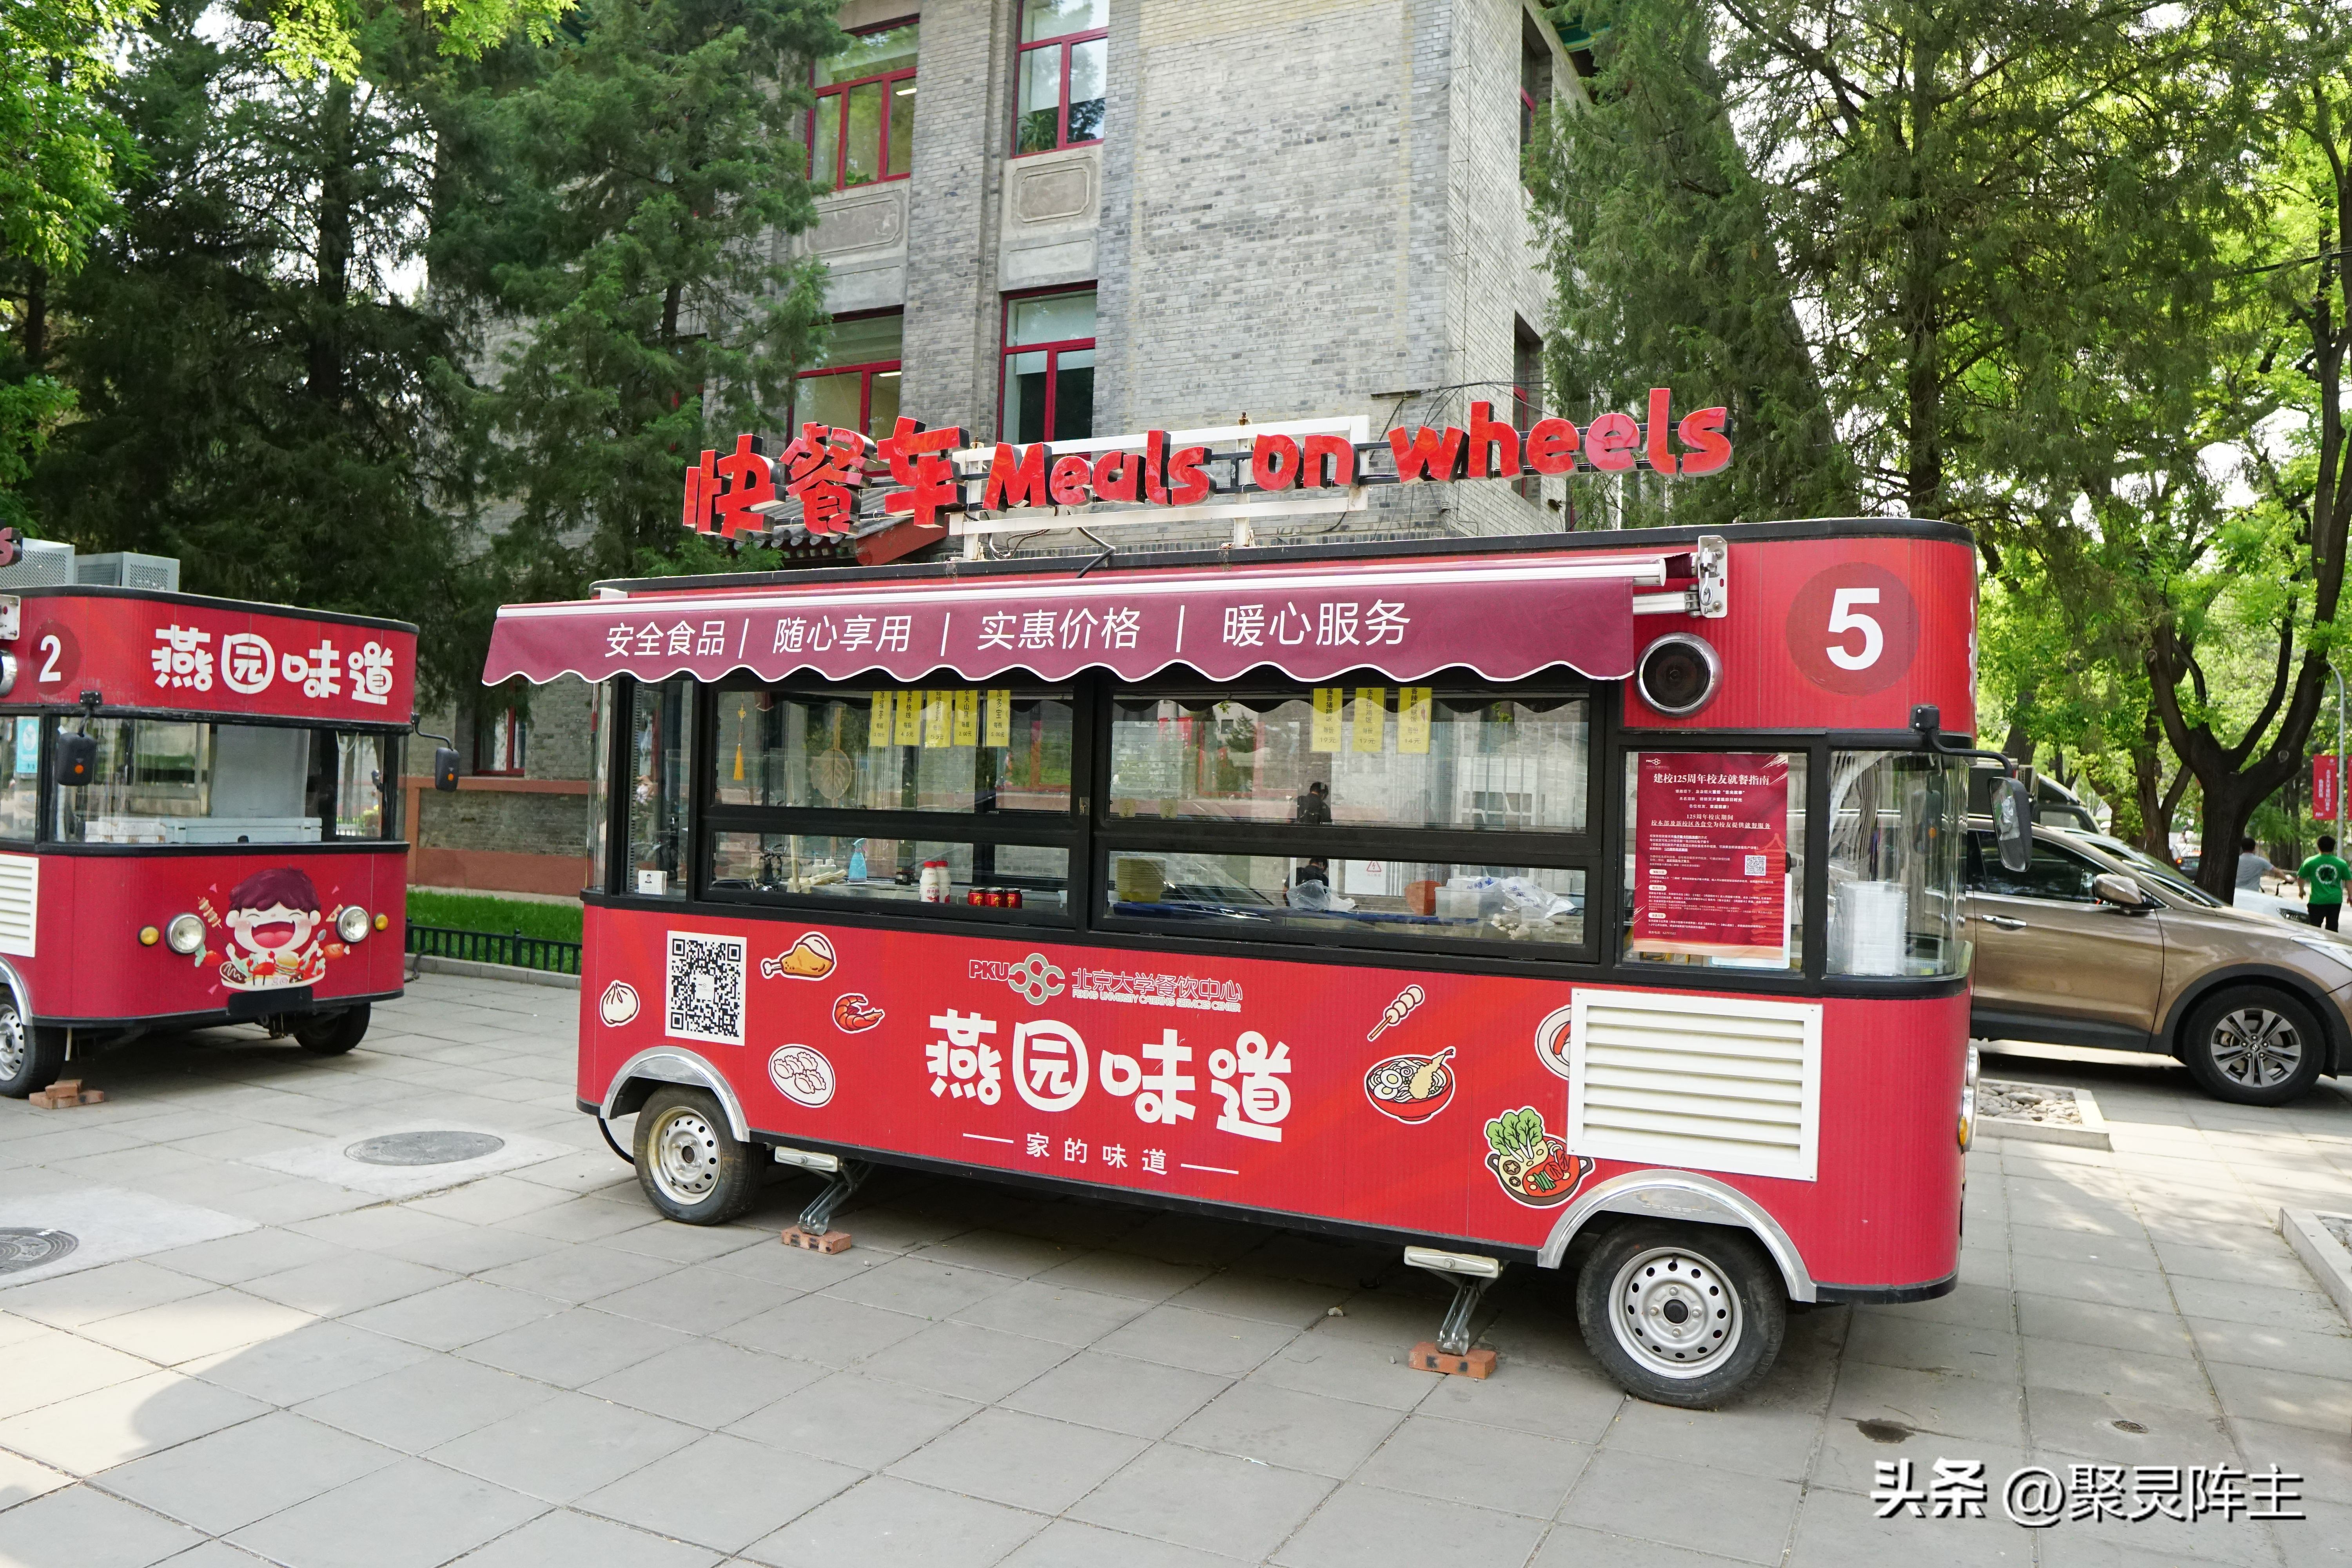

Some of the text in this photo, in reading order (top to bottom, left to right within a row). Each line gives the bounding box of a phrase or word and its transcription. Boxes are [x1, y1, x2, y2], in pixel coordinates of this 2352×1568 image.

[683, 388, 1733, 539] 快餐车 Meals on wheels
[605, 599, 1411, 658] 安全食品 随心享用 实惠价格 暖心服务
[1826, 588, 1883, 670] 5
[39, 635, 61, 682] 2
[151, 625, 394, 705] 燕园味道
[1653, 773, 1770, 786] 建校125周年校友就餐指南
[969, 960, 1010, 981] PKU
[1072, 967, 1243, 1002] 北京大学餐饮中心
[1072, 989, 1241, 1012] PEKING UNIVERSITY CATERING SERVICES CENTER
[926, 1008, 1291, 1143] 燕园味道
[1025, 1132, 1168, 1175] 家的味道
